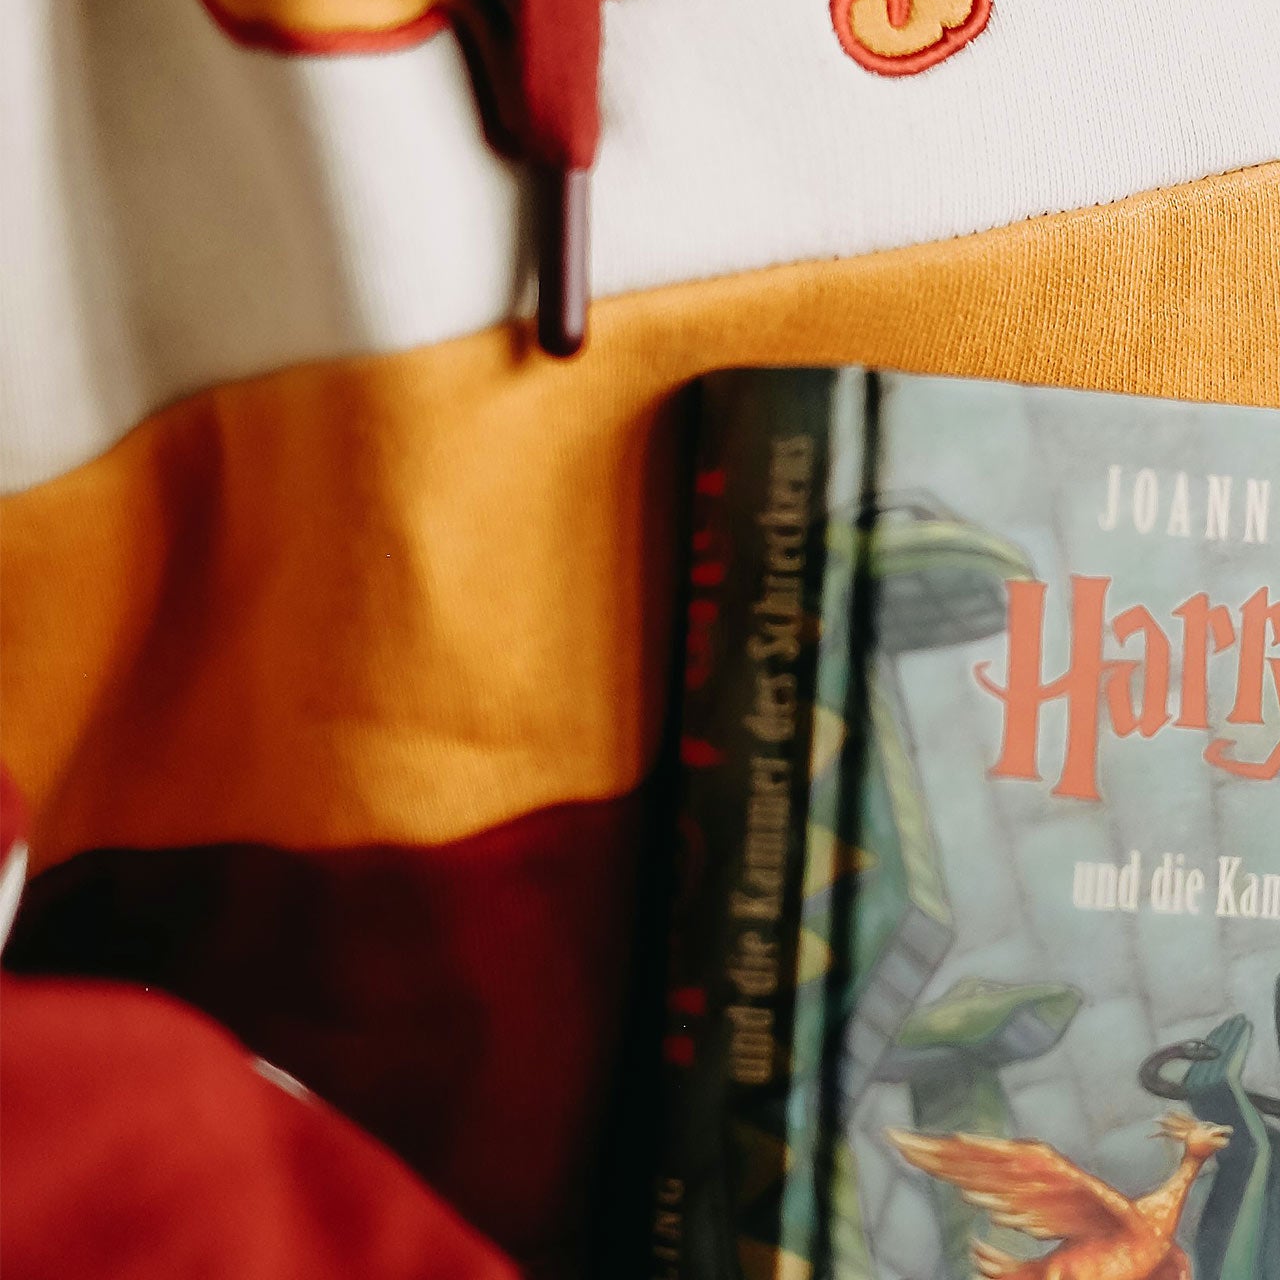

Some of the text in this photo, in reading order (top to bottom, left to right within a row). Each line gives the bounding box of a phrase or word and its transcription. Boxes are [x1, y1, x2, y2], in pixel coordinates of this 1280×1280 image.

[740, 671, 799, 743] des
[729, 756, 792, 920] Kammer
[1073, 849, 1140, 913] und
[1150, 851, 1205, 916] die
[727, 932, 779, 995] die
[725, 1005, 775, 1085] und
